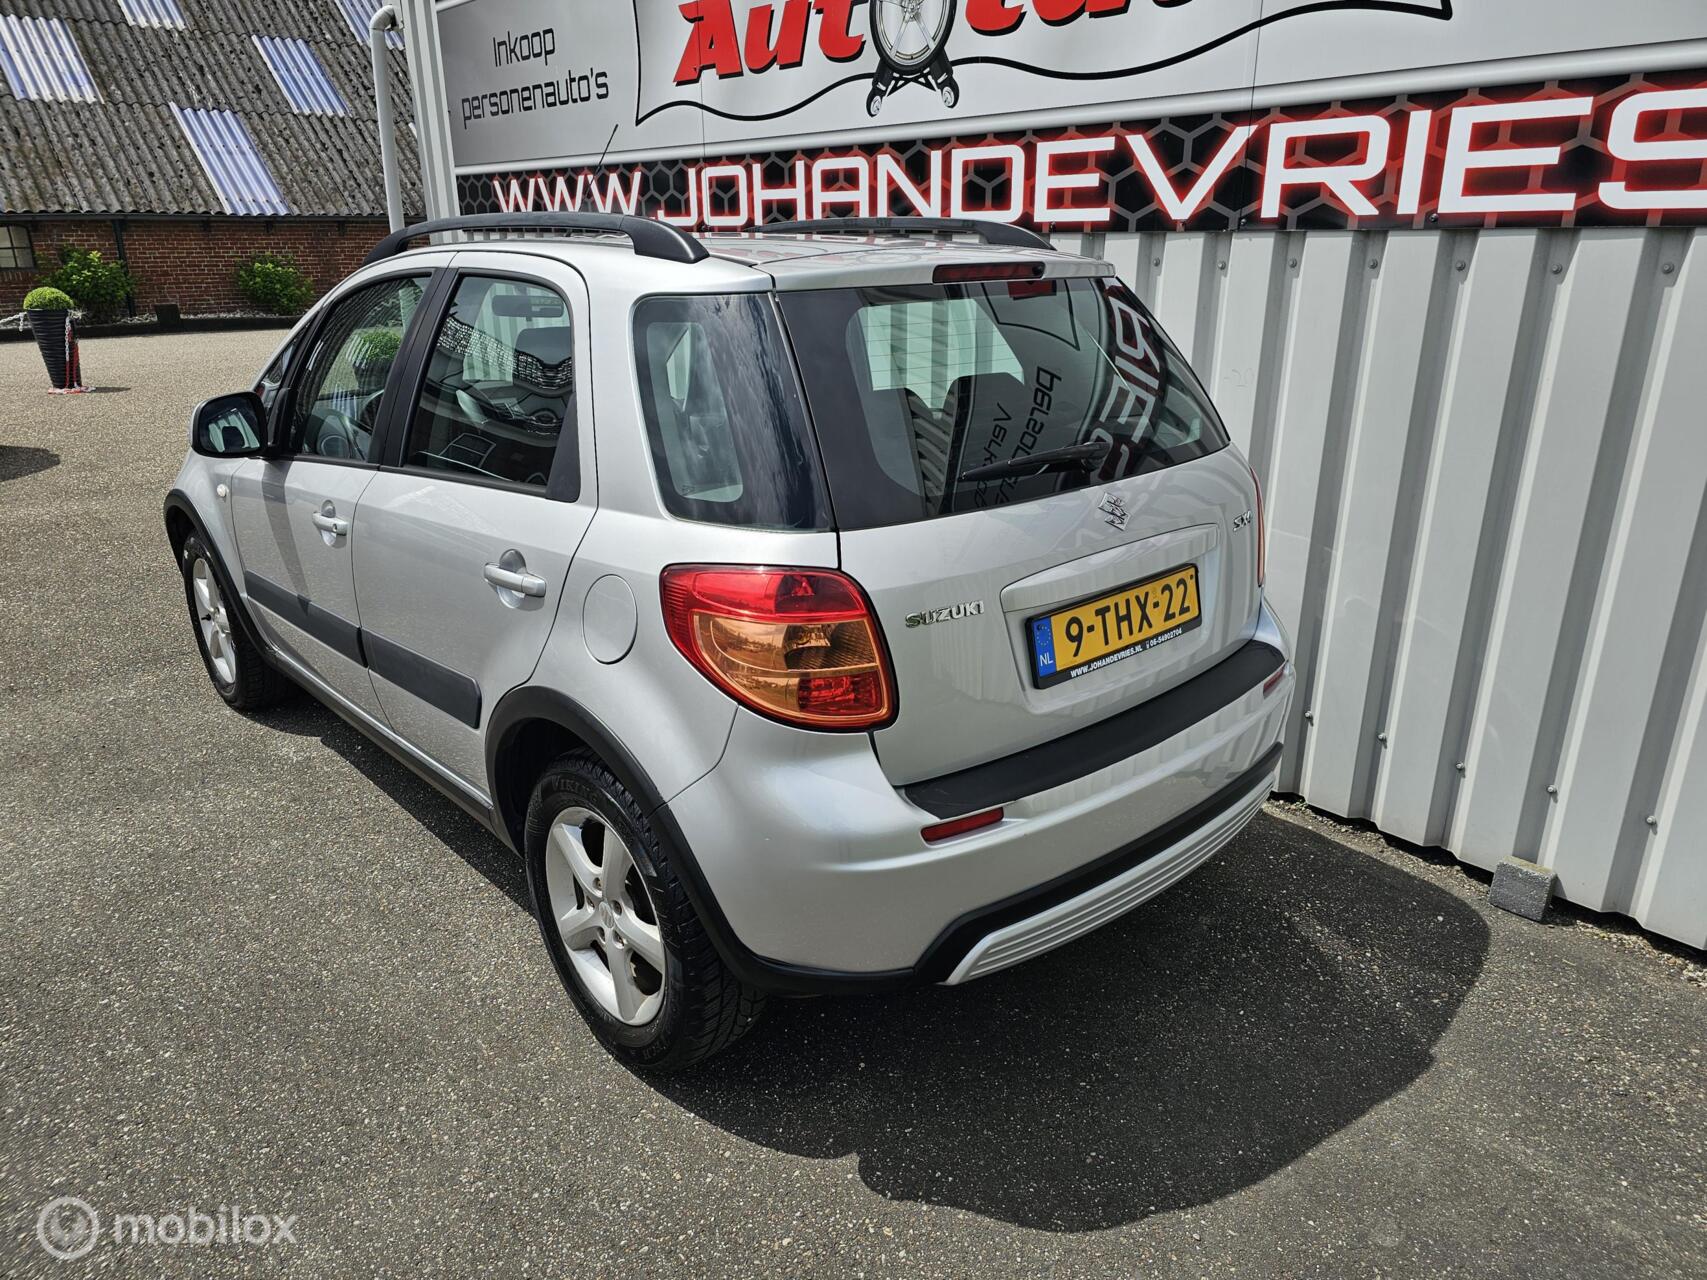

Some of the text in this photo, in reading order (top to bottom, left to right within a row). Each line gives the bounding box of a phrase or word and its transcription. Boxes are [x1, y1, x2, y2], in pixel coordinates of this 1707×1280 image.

[492, 27, 556, 67] Inkoop
[461, 67, 609, 130] personenauto's
[905, 600, 985, 628] SUZUKI
[1065, 577, 1191, 658] 9-THX-22
[1039, 652, 1054, 667] NL
[1070, 645, 1143, 678] WWW.JOHANDEVRIES.NL
